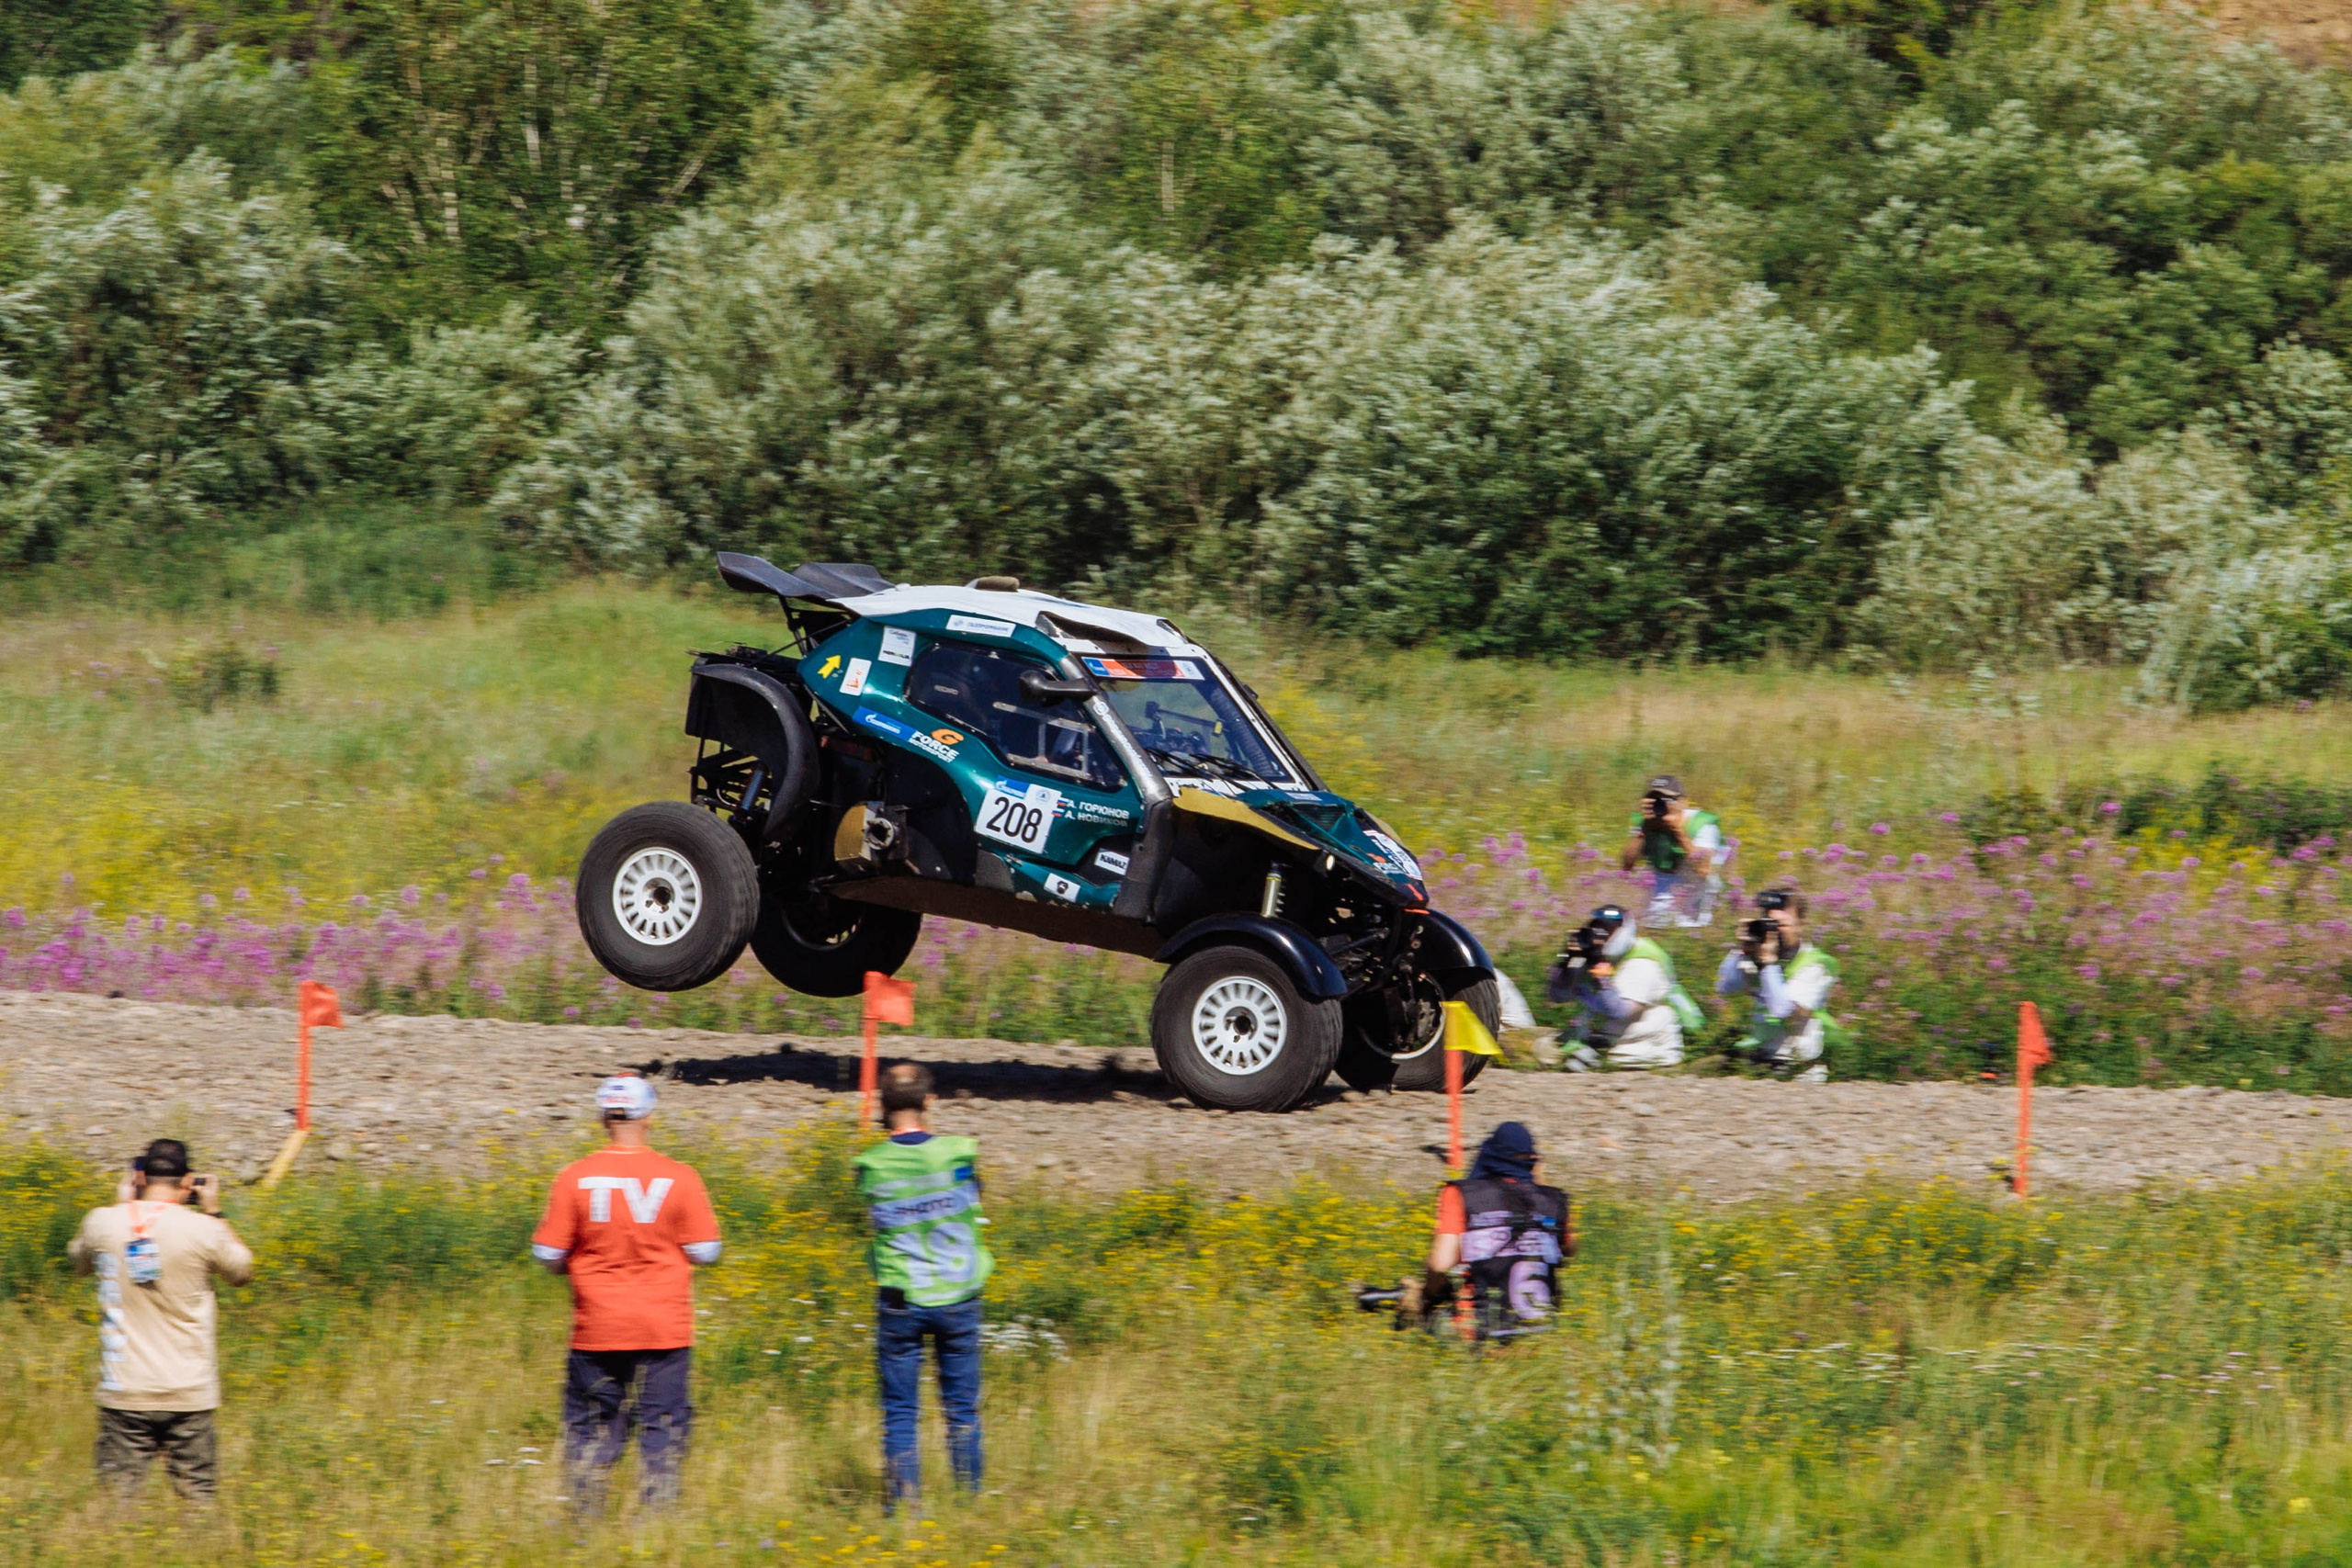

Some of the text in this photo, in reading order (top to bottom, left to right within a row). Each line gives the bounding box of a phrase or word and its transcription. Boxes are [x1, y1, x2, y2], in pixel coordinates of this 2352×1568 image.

[911, 730, 960, 759] FORCE
[986, 796, 1043, 843] 208
[1077, 812, 1128, 827] НОВИКОВ
[1079, 801, 1130, 819] ГОРЮНОВ
[578, 1176, 675, 1224] TV
